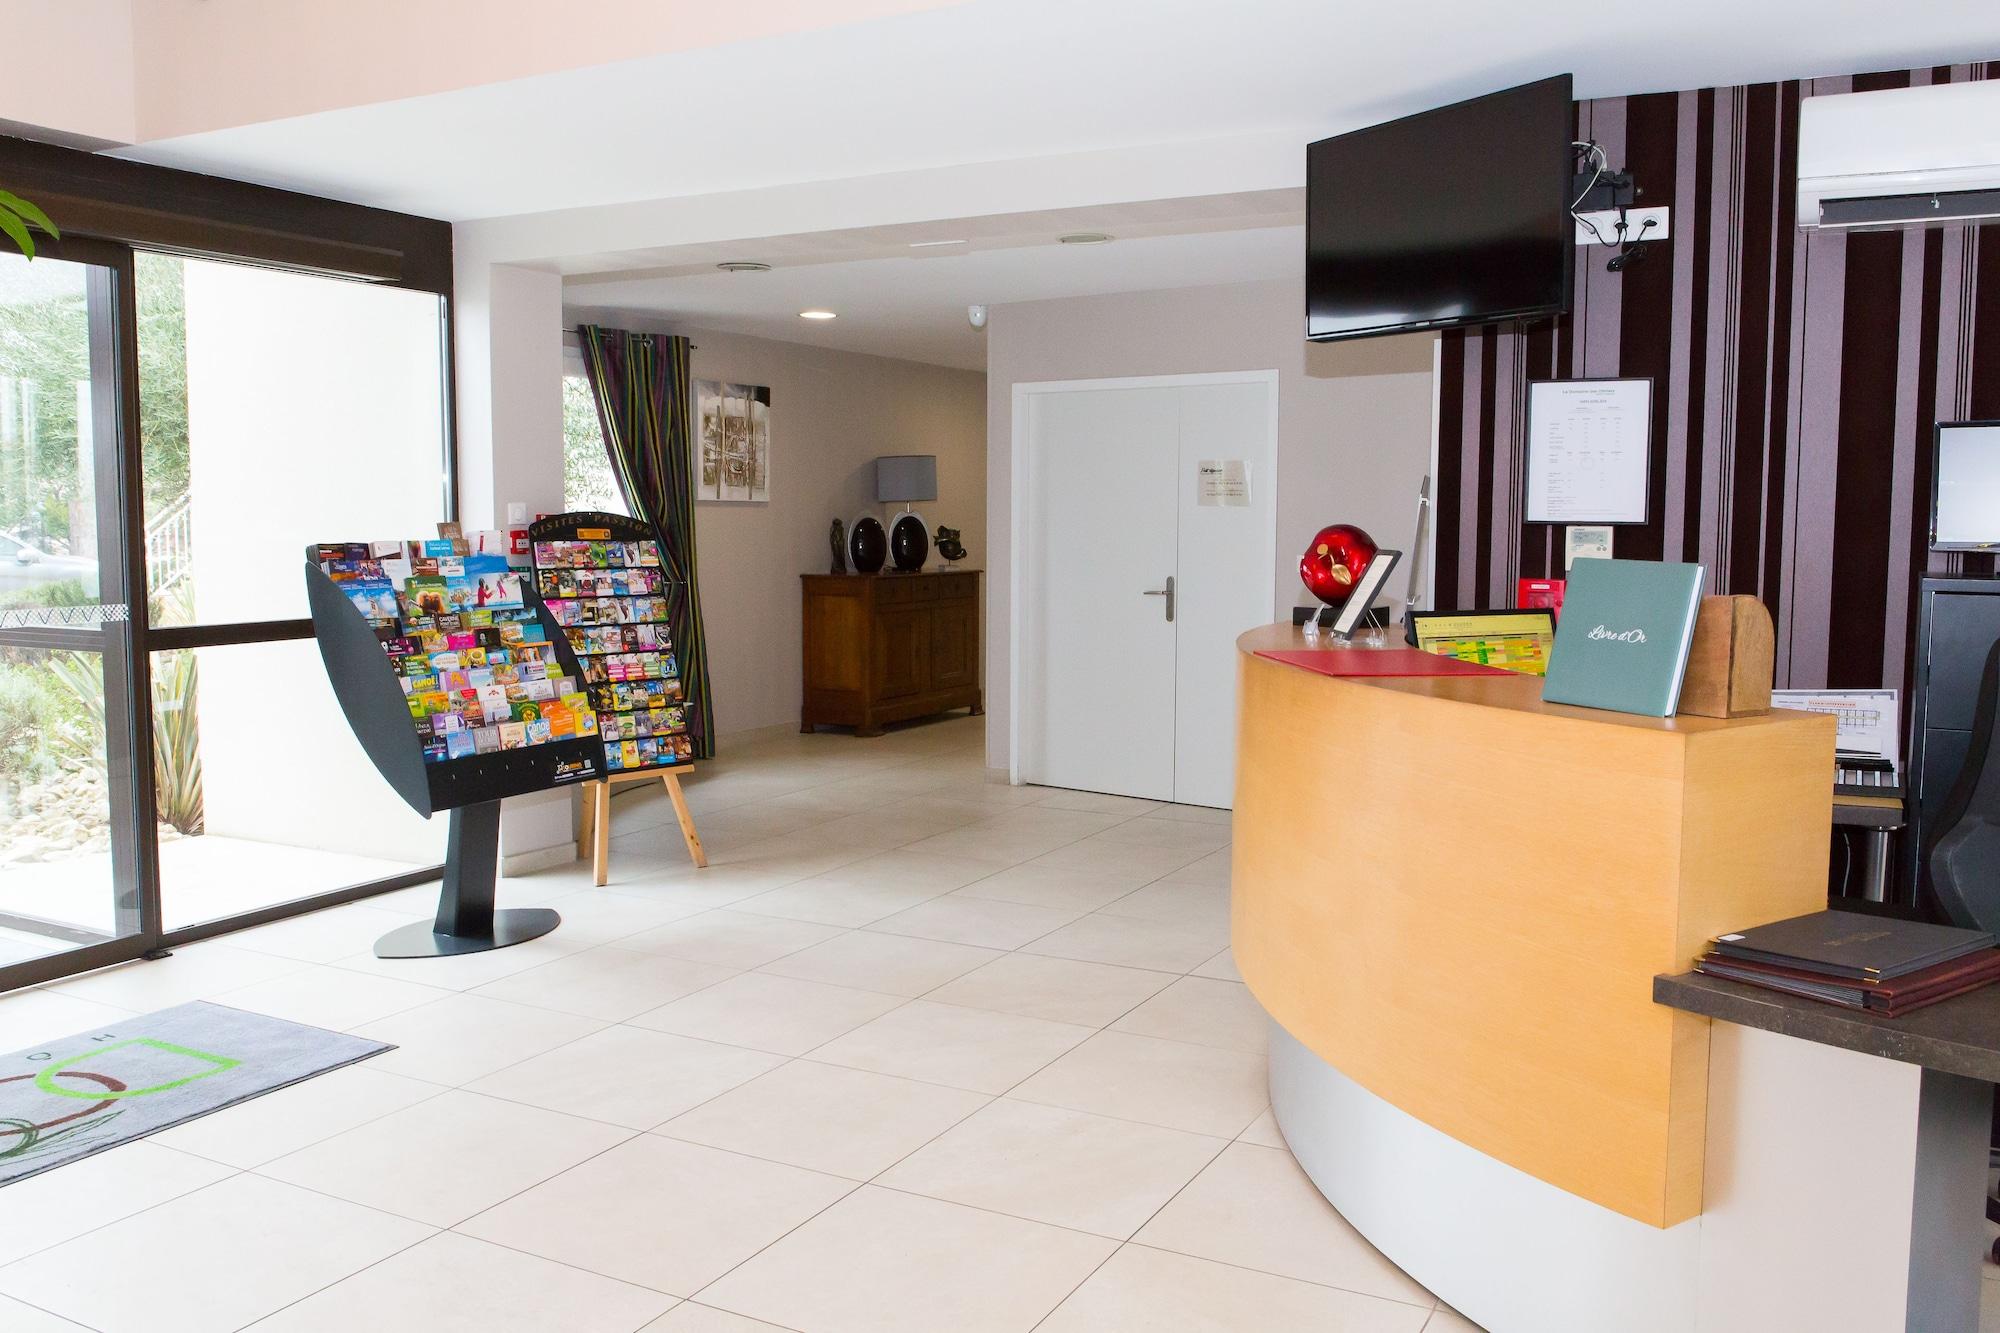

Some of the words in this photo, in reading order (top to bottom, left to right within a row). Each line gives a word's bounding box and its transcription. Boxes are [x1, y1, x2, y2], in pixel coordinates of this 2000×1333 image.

[531, 515, 583, 537] VISITES
[594, 514, 652, 536] PASSION
[1588, 624, 1618, 640] Livre
